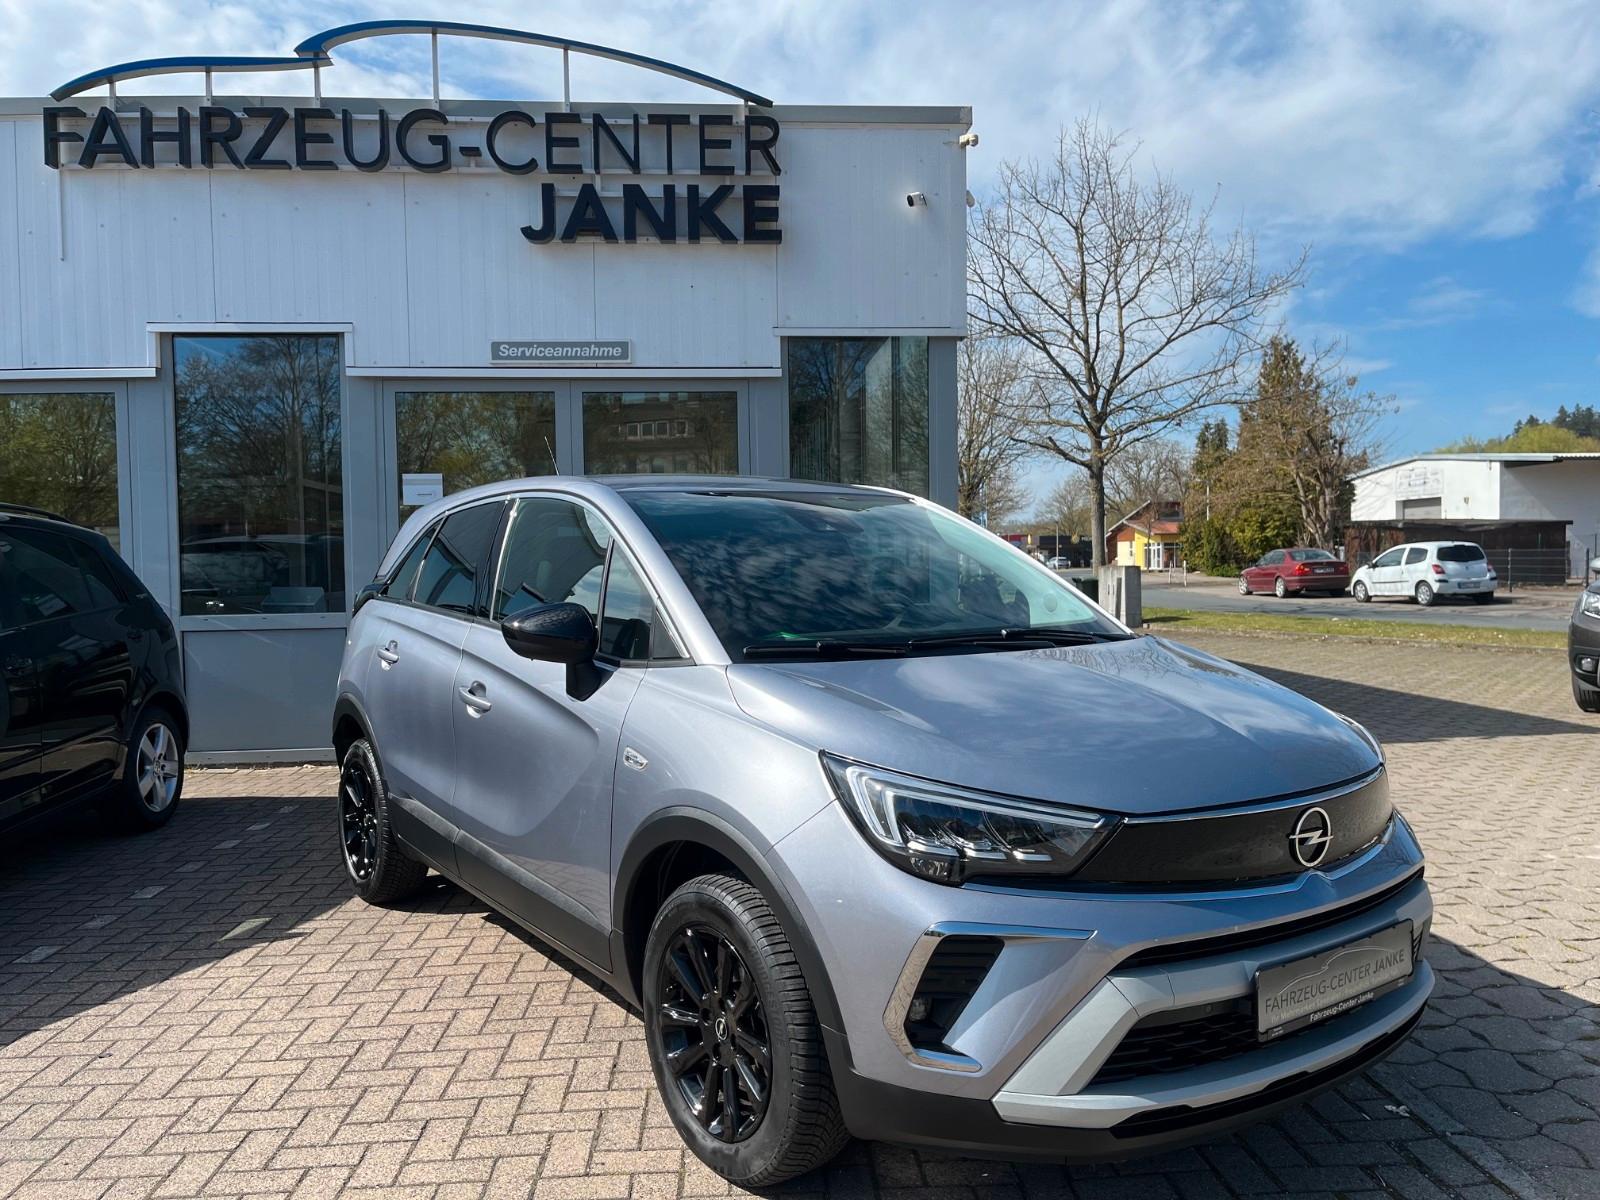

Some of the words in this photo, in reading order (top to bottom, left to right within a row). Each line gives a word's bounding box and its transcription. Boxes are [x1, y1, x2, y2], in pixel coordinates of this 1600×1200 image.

[43, 106, 782, 176] FAHRZEUG-CENTER
[521, 182, 783, 245] JANKE
[498, 343, 623, 358] Serviceannahme
[1265, 962, 1371, 1015] FAHRZEUG-CENTER
[1373, 949, 1405, 974] JANKE
[1310, 997, 1359, 1022] Fahrzeug-Center
